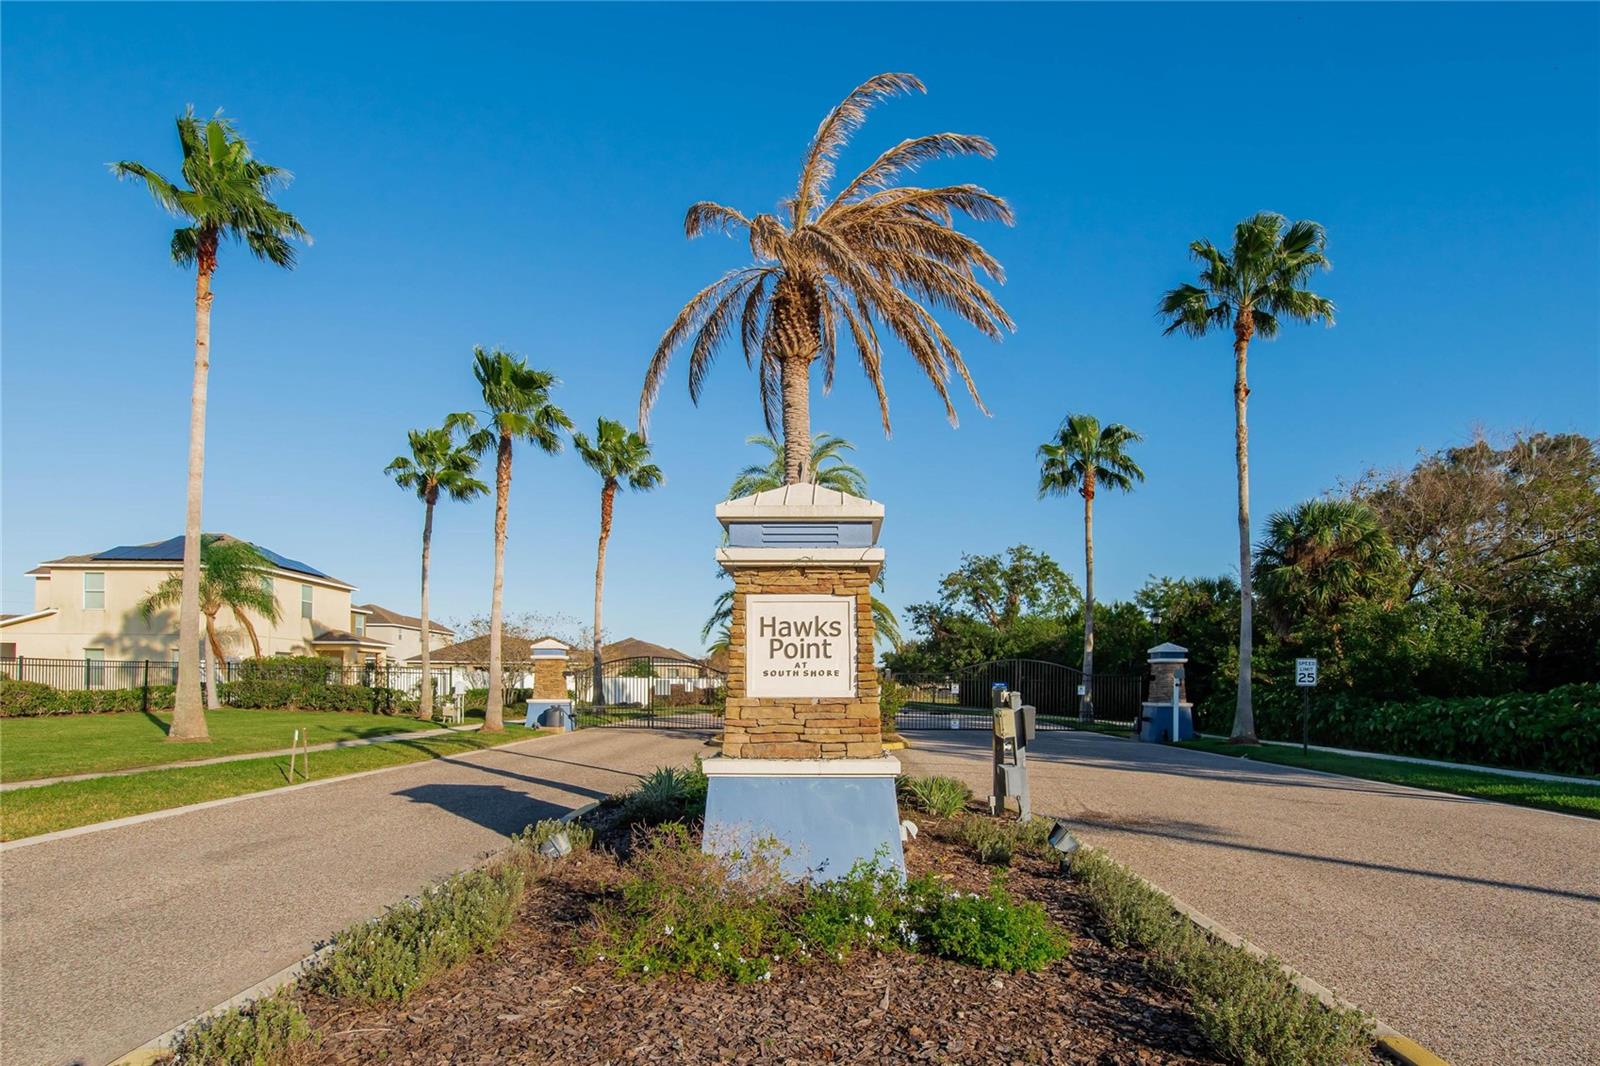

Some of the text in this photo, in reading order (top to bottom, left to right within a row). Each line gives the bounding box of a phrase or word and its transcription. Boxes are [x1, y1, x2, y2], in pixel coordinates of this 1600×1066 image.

[759, 615, 842, 638] Hawks
[769, 638, 832, 659] Point
[794, 661, 808, 669] AT
[762, 669, 840, 677] SOUTH SHORE
[1298, 672, 1315, 683] 25
